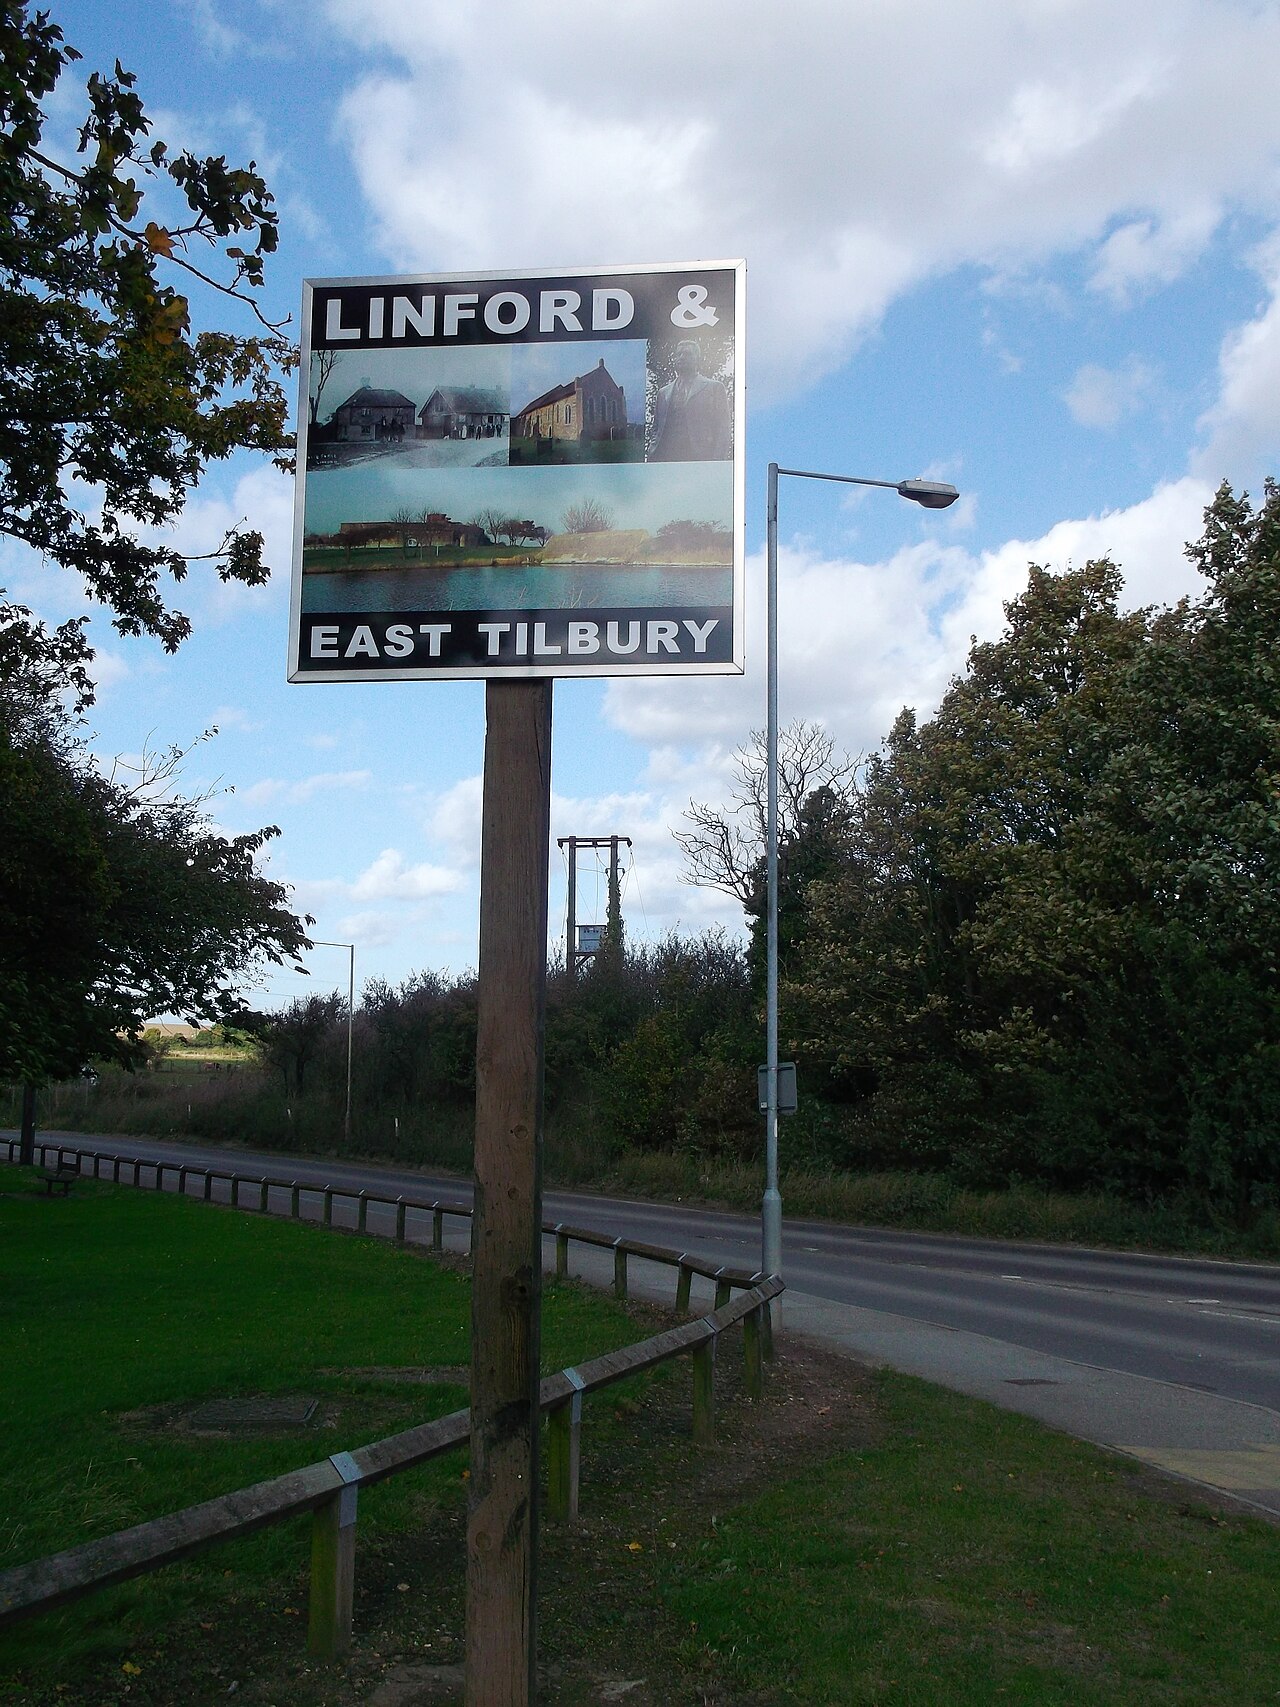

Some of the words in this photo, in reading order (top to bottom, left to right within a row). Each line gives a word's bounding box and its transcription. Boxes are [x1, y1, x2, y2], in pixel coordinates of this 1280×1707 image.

[325, 288, 635, 340] LINFORD
[670, 284, 720, 328] &
[310, 623, 452, 658] EAST
[478, 619, 720, 656] TILBURY
